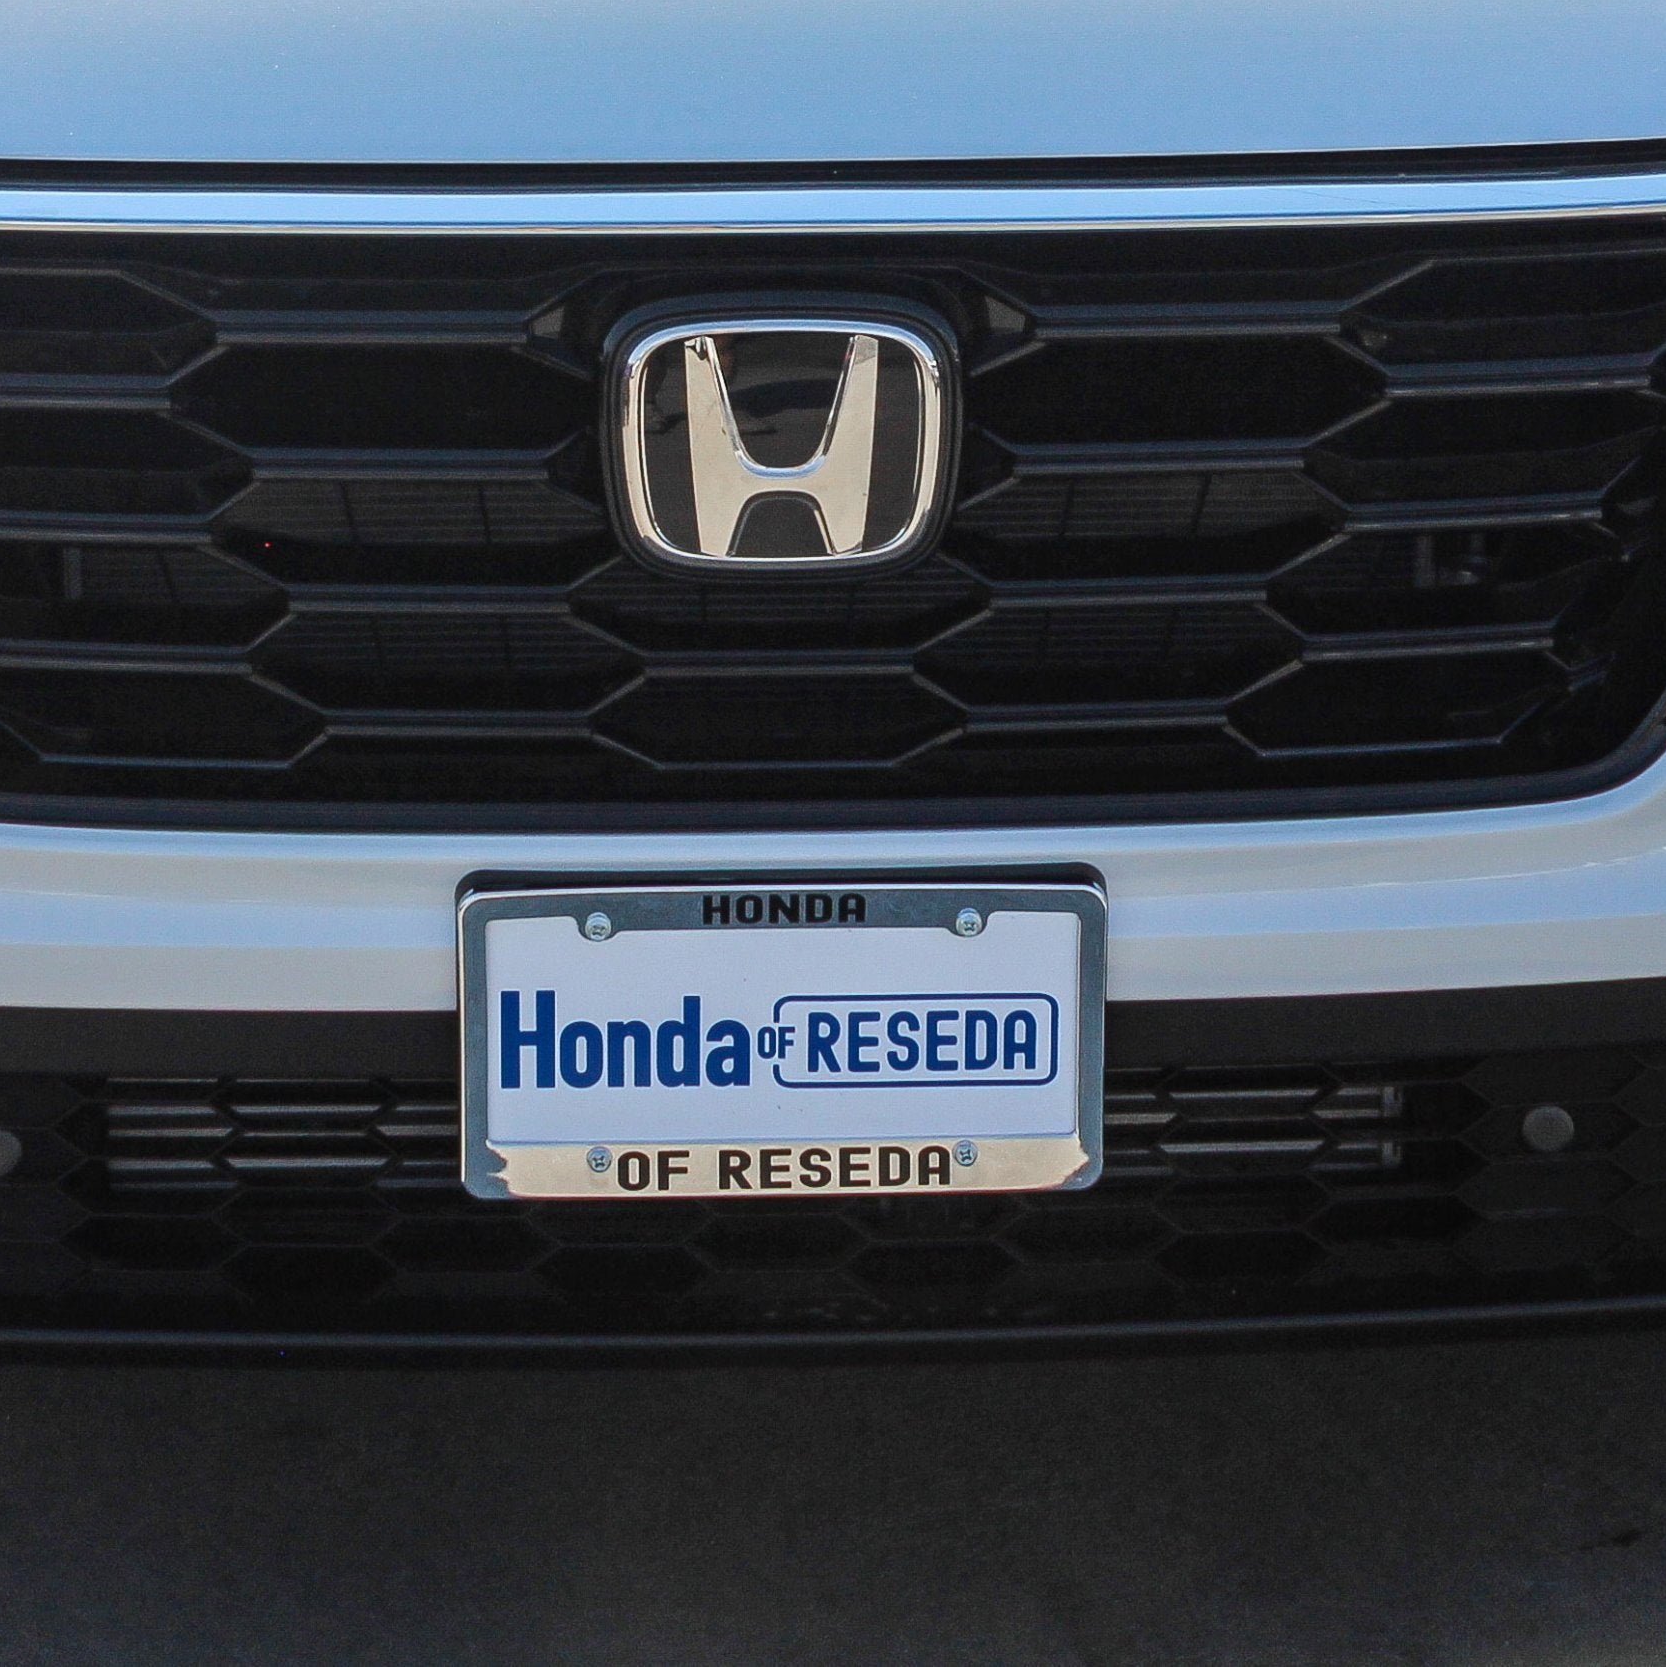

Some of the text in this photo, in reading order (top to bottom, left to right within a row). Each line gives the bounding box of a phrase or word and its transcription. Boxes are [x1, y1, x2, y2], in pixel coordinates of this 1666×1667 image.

[701, 892, 867, 926] HONDA
[500, 989, 1038, 1090] Honda OF RESEDA
[616, 1145, 952, 1192] OF RESEDA
